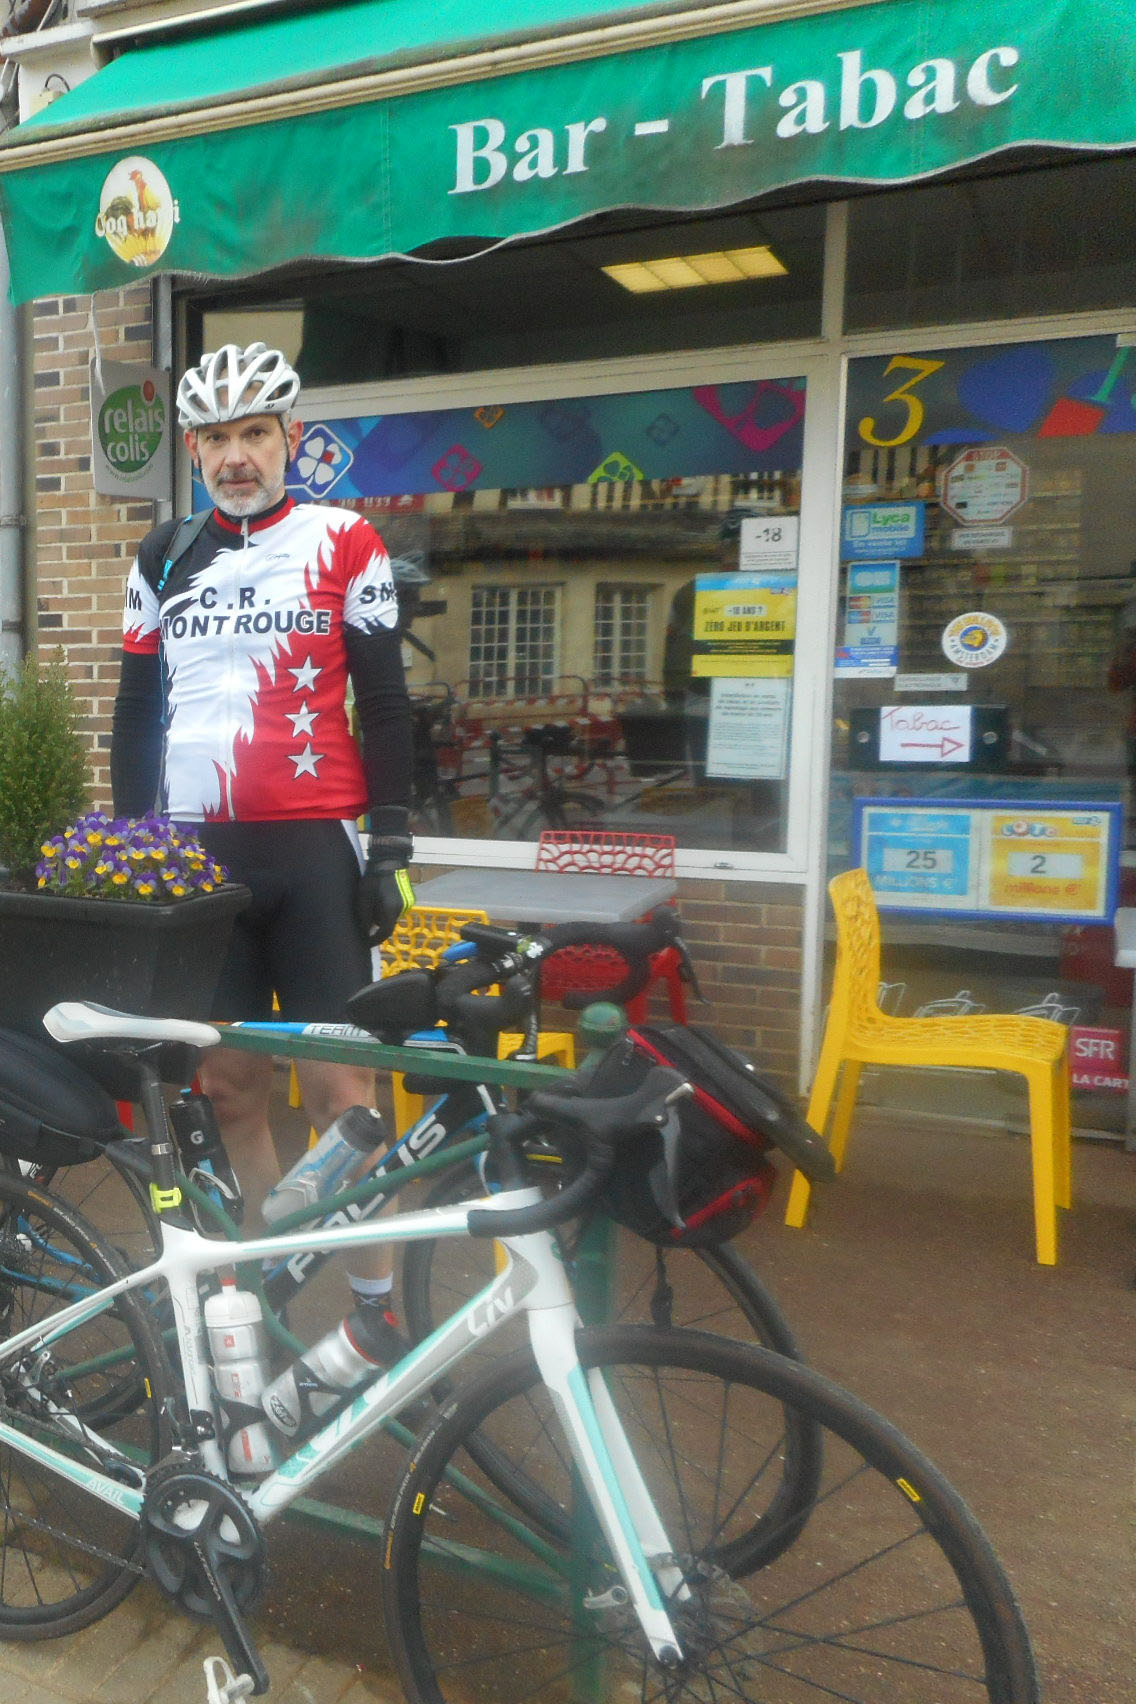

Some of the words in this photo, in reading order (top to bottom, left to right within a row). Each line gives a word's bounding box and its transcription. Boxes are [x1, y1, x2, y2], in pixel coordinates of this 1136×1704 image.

[448, 118, 607, 194] Bar
[701, 46, 1020, 150] Tabac
[858, 355, 945, 447] 3
[104, 399, 165, 434] relais
[107, 434, 150, 462] colis
[873, 511, 911, 526] Lyca
[878, 706, 961, 732] Tabac
[905, 850, 938, 870] 25
[1030, 854, 1047, 874] 2
[311, 1024, 362, 1037] TEAM
[1075, 1038, 1116, 1060] SFR
[1072, 1073, 1090, 1085] LA
